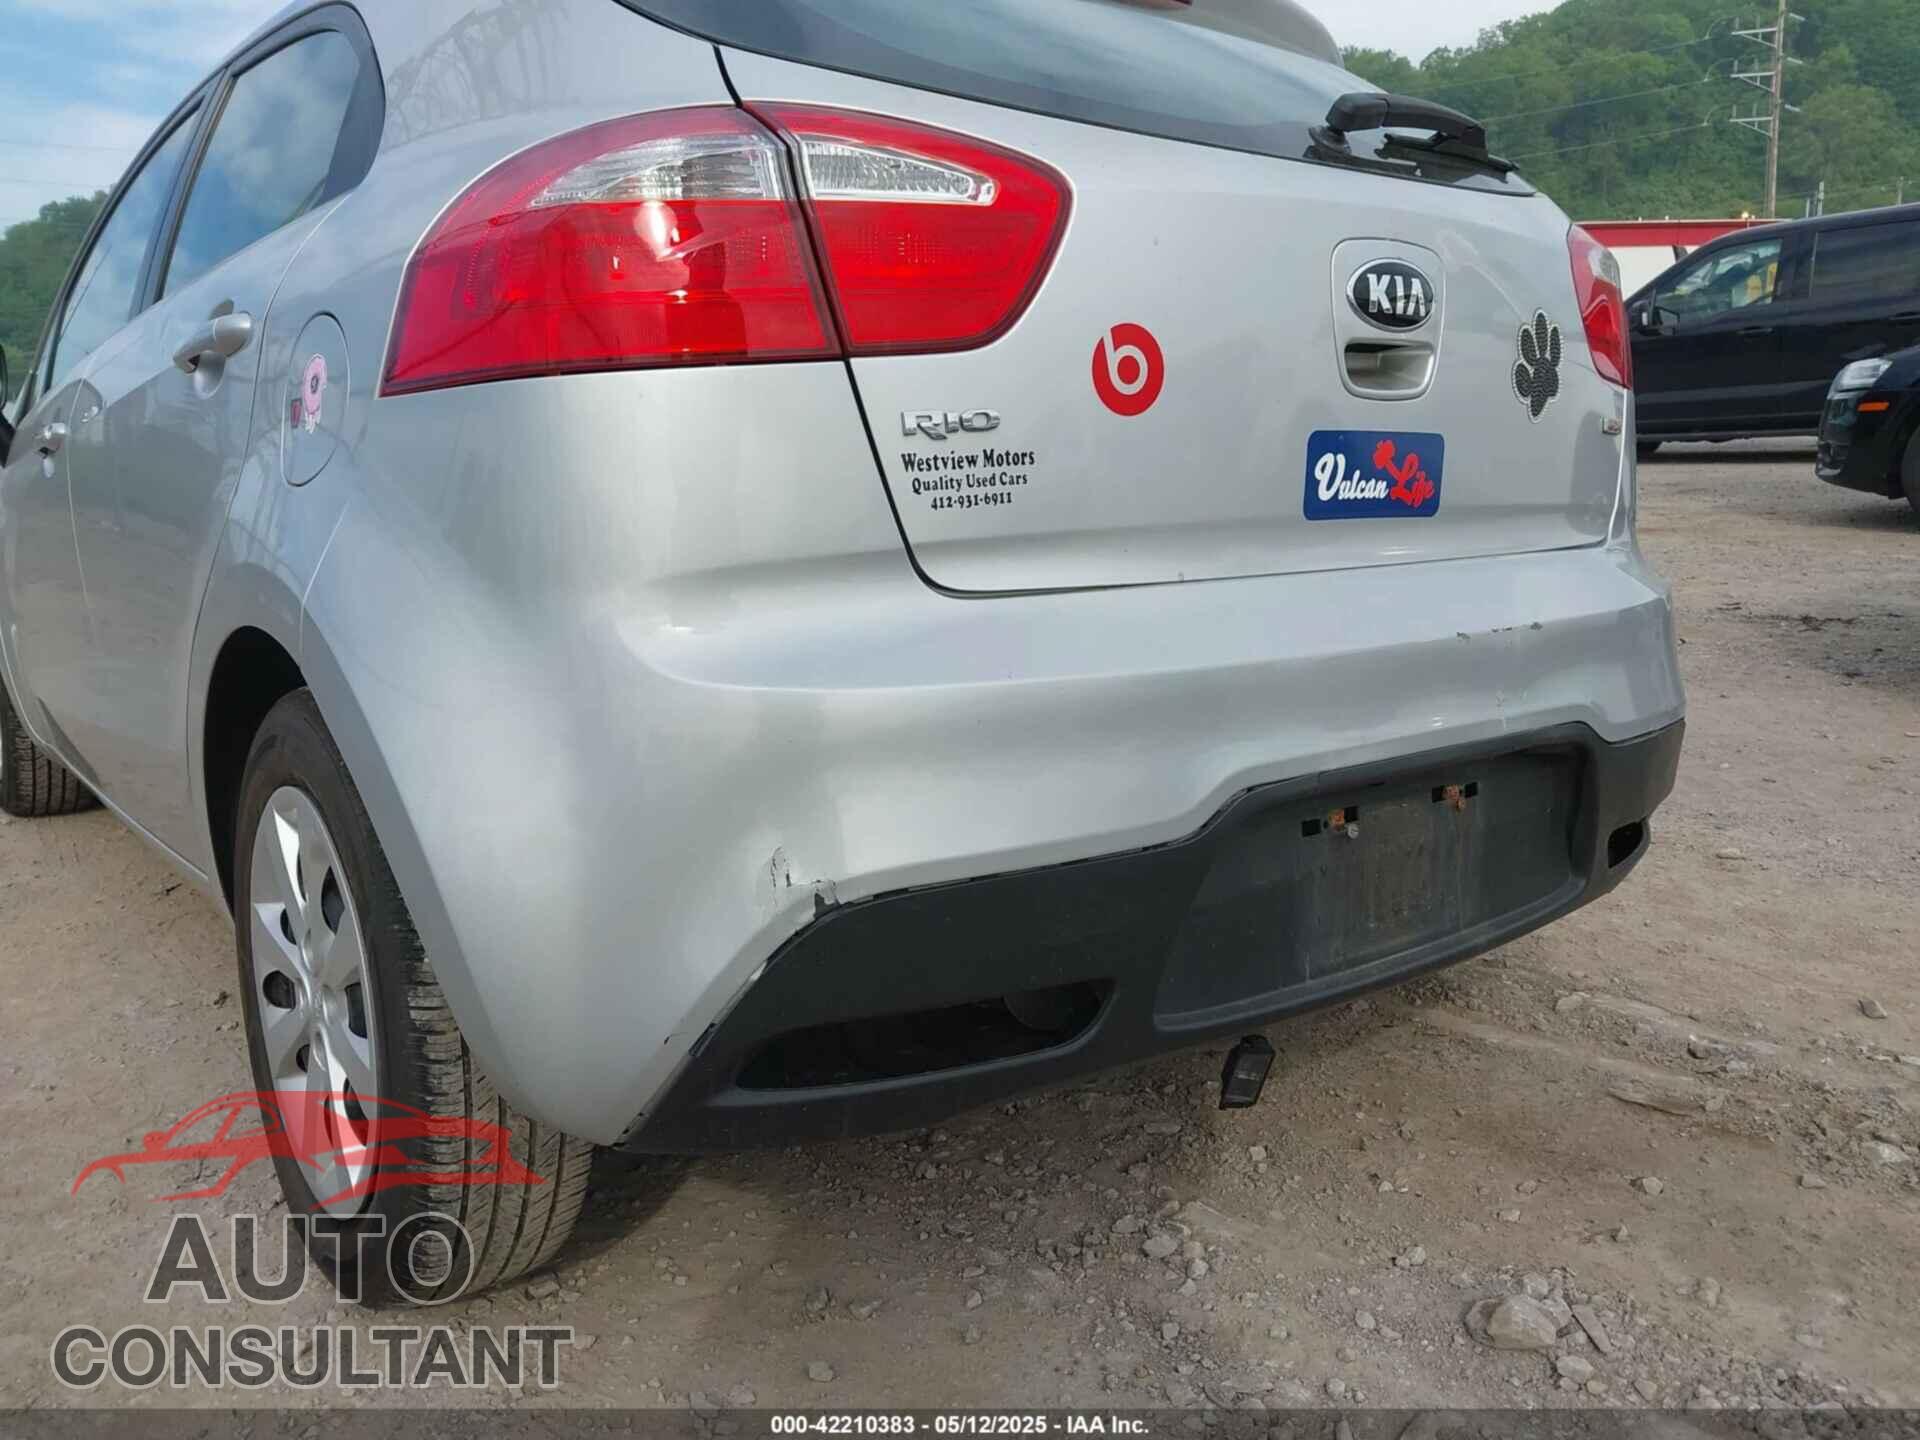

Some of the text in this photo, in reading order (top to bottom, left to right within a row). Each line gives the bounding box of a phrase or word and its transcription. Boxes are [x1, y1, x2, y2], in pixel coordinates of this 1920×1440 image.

[1367, 274, 1426, 316] KIA
[901, 409, 1001, 440] RIO
[901, 449, 1036, 473] Westview Motors
[1314, 452, 1389, 501] Vulcan
[911, 471, 1028, 495] Quality Used Cars
